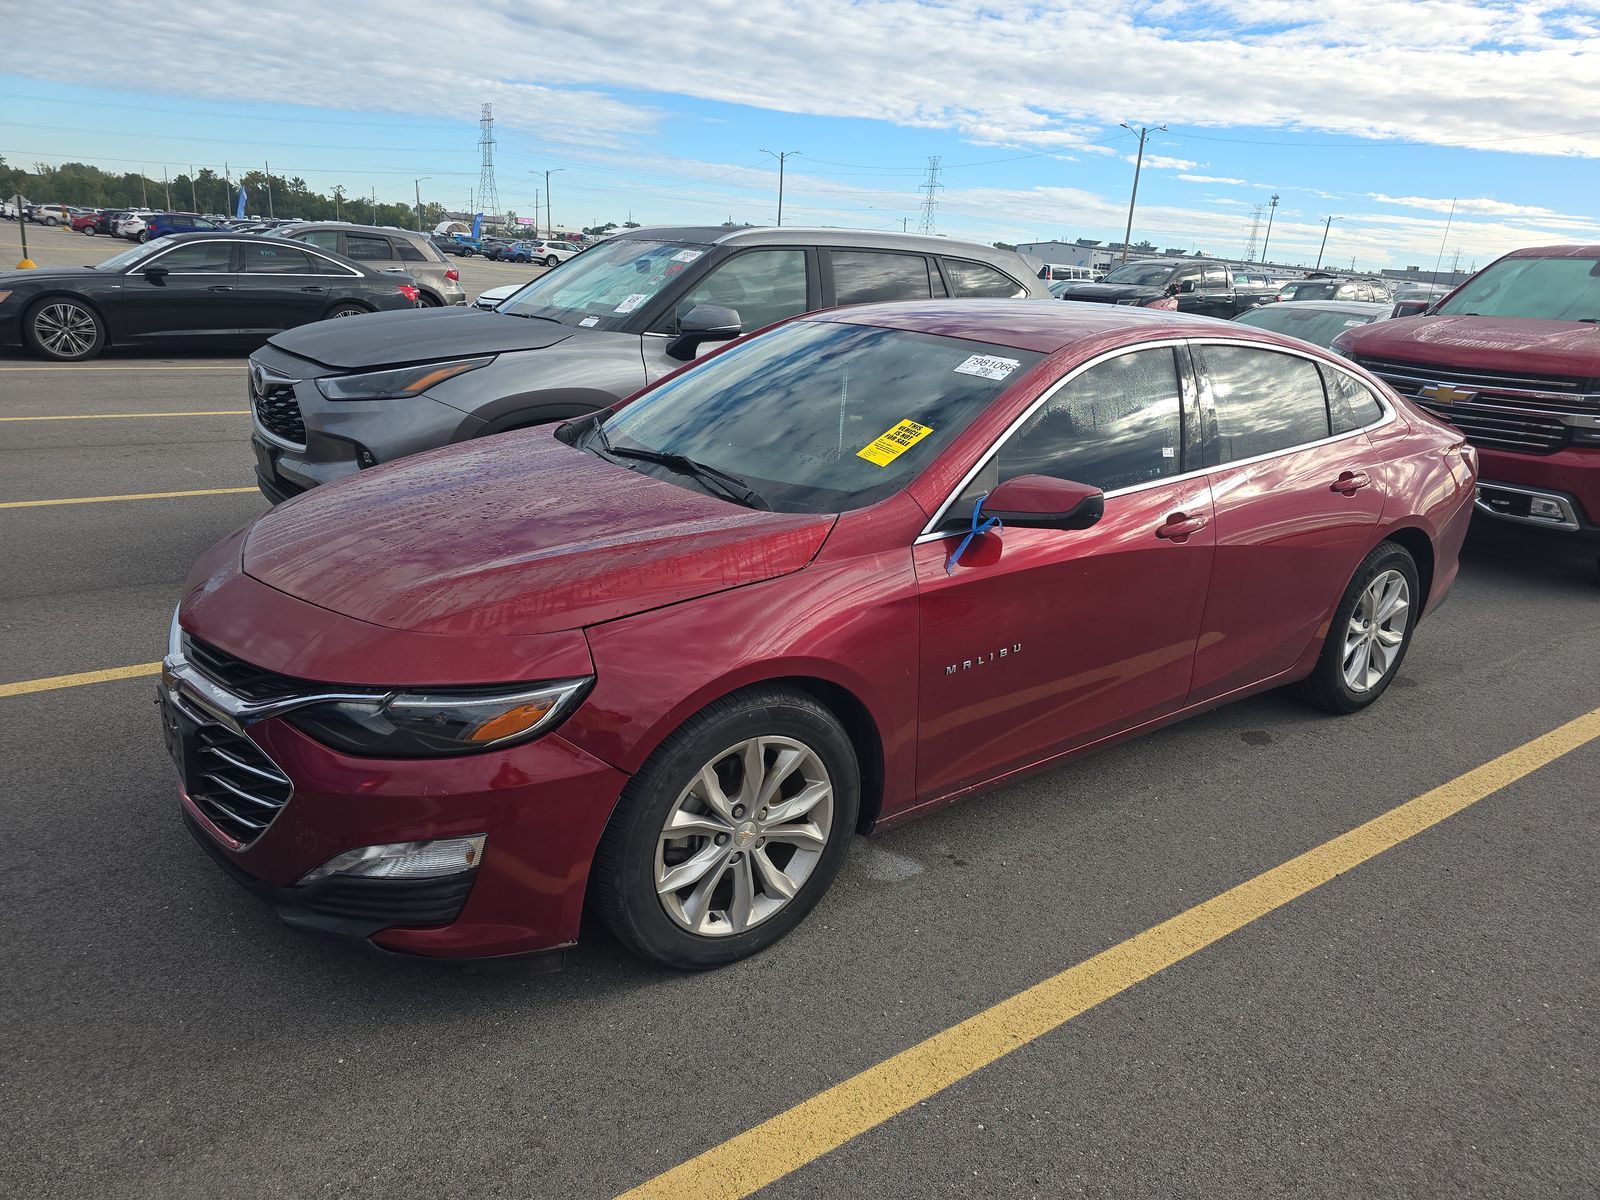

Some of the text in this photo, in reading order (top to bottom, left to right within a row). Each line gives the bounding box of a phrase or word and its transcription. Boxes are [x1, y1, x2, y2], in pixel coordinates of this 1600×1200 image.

[967, 356, 1018, 372] 7981066
[898, 425, 922, 437] VEHICLE
[909, 422, 924, 431] THIS
[884, 433, 897, 441] FOR
[894, 438, 911, 447] SALE
[902, 432, 914, 441] NOT
[945, 643, 1022, 676] MALIBU
